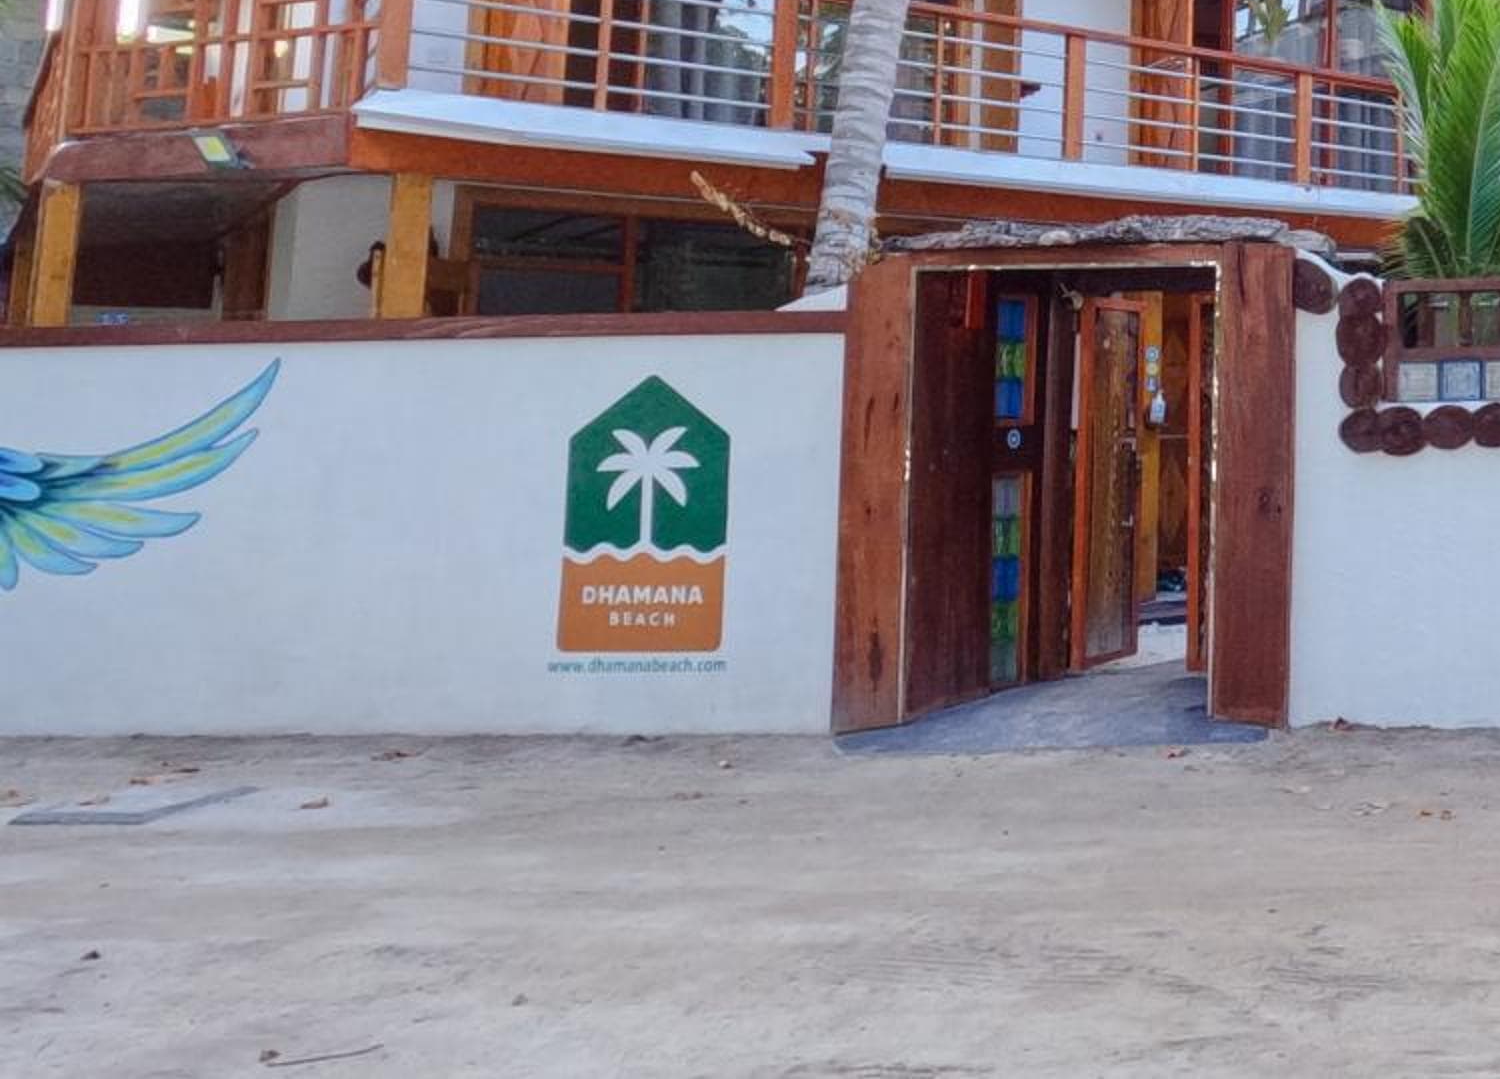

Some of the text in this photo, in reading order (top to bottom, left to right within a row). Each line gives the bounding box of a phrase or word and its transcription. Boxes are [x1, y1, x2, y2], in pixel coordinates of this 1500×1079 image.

[581, 585, 703, 605] DHAMANA
[608, 611, 676, 626] BEACH
[547, 657, 727, 673] www.dhamanabeach.com
